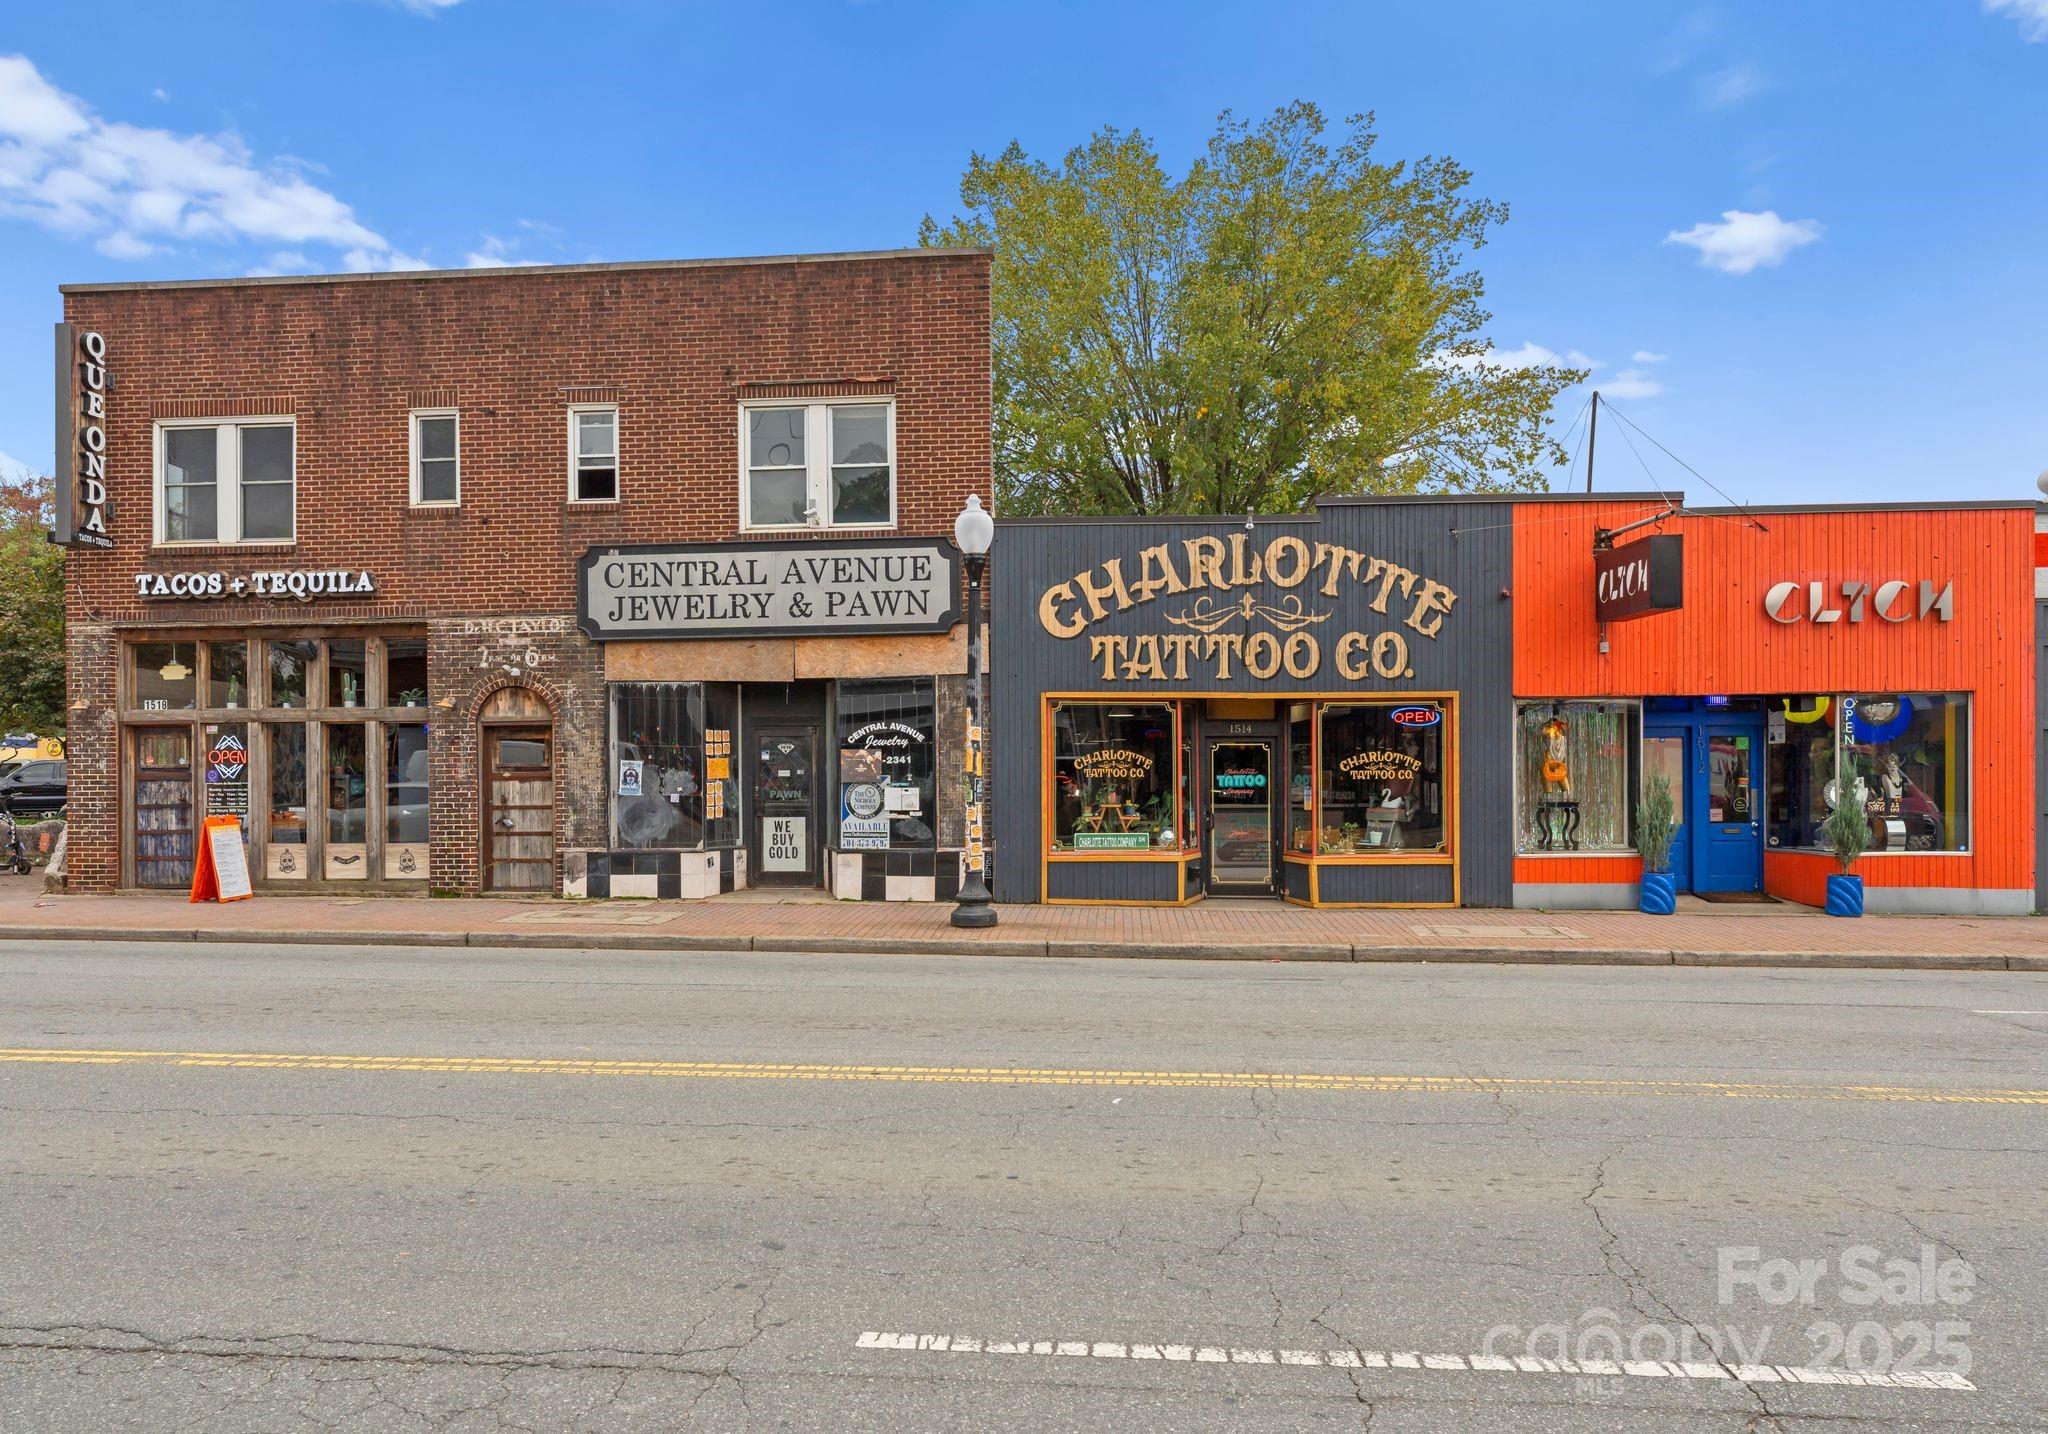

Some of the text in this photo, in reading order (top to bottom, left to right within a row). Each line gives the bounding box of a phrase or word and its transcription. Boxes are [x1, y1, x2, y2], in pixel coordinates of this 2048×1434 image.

[86, 332, 106, 533] QUE ONDA
[603, 555, 931, 589] CENTRAL AVENUE
[135, 571, 374, 597] TACOS + TEQUILA
[1038, 532, 1458, 639] CHARLOTTE
[1599, 559, 1648, 603] CLTCH
[608, 589, 930, 622] JEWELRY & PAWN
[1765, 579, 1953, 624] CLTCH
[525, 647, 539, 667] 6
[1090, 631, 1415, 681] TATTOO CO.
[145, 700, 167, 710] 1518
[1394, 712, 1435, 723] OPEN
[847, 722, 926, 744] CENTRAL AVENUE
[1230, 724, 1252, 734] 1514
[864, 735, 909, 750] Jewelry
[1696, 725, 1706, 774] 1512
[208, 750, 247, 764] OPEN
[882, 756, 912, 764] -2341
[1073, 749, 1153, 770] CHARLOTTE
[1339, 751, 1422, 772] CHARLOTTE
[1083, 768, 1145, 778] TATTOO CO.
[1350, 770, 1414, 780] TATTOO CO.
[1216, 774, 1267, 788] TATTOO
[769, 790, 802, 799] PAWN
[1226, 788, 1255, 797] Company
[774, 820, 791, 833] WE
[844, 822, 888, 831] AVAILABLE
[772, 833, 795, 846] BUY
[1079, 837, 1102, 847] CHARLOTTE
[1102, 837, 1118, 847] TATTOO
[1118, 837, 1137, 847] COMPANY
[769, 846, 798, 859] GOLD
